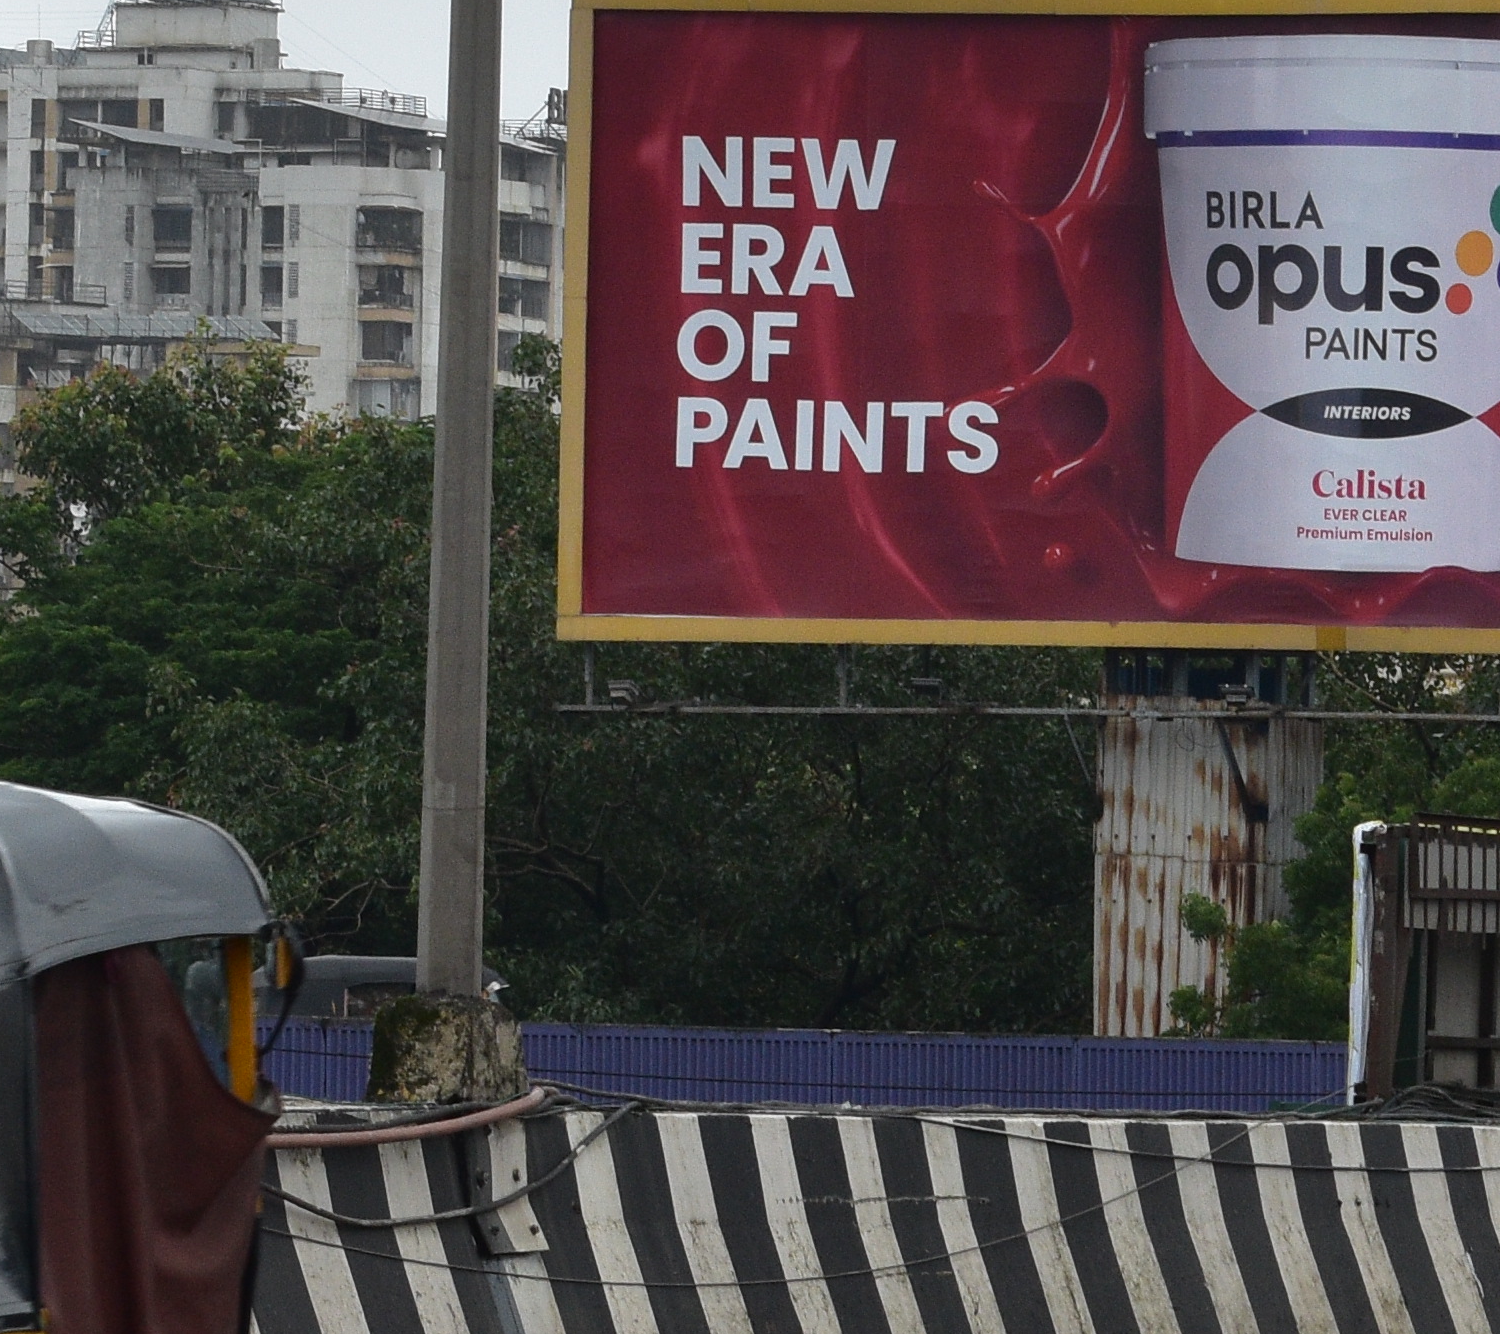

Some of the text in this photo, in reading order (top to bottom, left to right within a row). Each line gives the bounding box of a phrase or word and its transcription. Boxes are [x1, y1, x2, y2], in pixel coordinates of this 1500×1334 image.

[681, 134, 897, 211] NEW
[1205, 189, 1325, 230] BIRLA
[680, 222, 856, 298] ERA
[676, 308, 799, 383] OF
[1304, 326, 1439, 363] PAINTS
[1323, 404, 1412, 422] INTERIORS
[675, 395, 1000, 475] PAINTS
[1311, 468, 1428, 501] Calista
[1296, 525, 1434, 543] Premium Emulsion
[1323, 507, 1407, 523] EVER CLEAR
